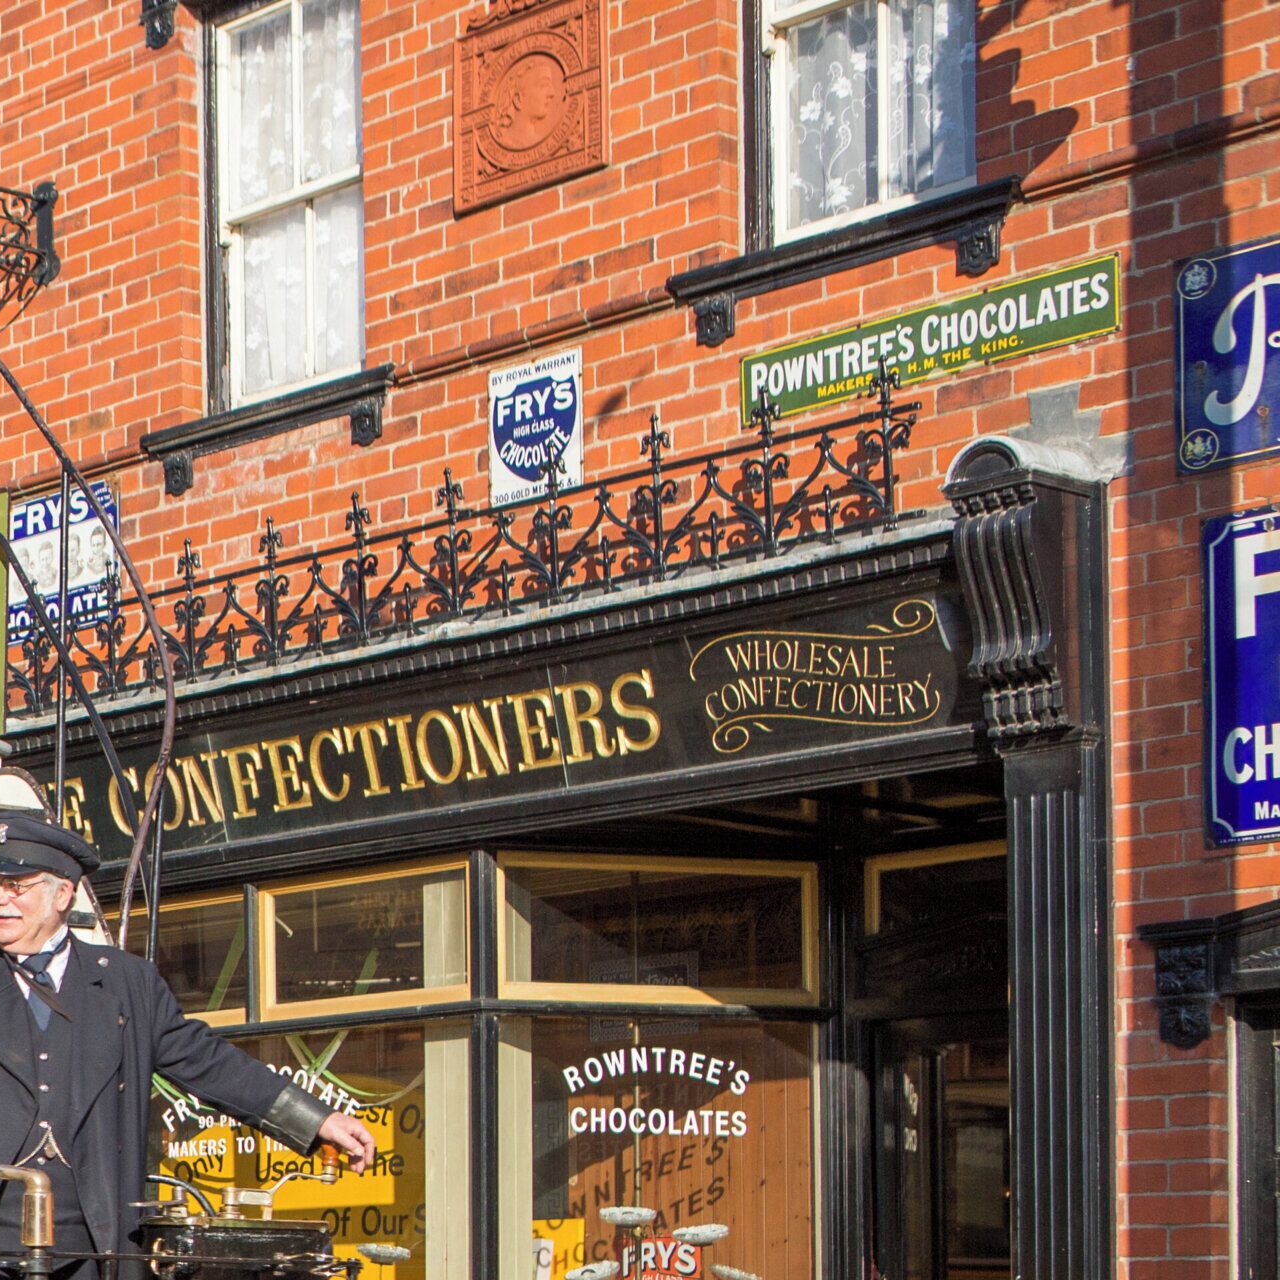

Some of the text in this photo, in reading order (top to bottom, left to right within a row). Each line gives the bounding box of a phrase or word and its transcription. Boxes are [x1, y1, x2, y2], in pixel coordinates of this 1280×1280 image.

[751, 324, 914, 402] ROWNTREE'S
[921, 272, 1110, 355] CHOCOLATES
[492, 354, 576, 387] BY ROYAL WARRANT
[817, 373, 873, 398] MAKERS
[943, 347, 971, 366] THE
[981, 336, 1024, 355] KING.
[497, 381, 573, 427] FRY'S
[513, 419, 554, 439] HIGH CLASS
[494, 493, 509, 505] 300
[511, 488, 530, 500] GOLD
[725, 640, 896, 679] WHOLESALE
[705, 673, 932, 721] CONFECTIONERY
[108, 668, 661, 838] CONFECTIONERS
[562, 1046, 750, 1095] ROWNTREE'S
[198, 1117, 217, 1129] 90
[570, 1107, 747, 1137] CHOCOLATES
[168, 1138, 227, 1159] MAKERS
[236, 1136, 255, 1154] TO
[174, 1153, 224, 1184] Only
[256, 1151, 314, 1182] Used
[321, 1208, 351, 1238] Of
[361, 1205, 408, 1235] Our
